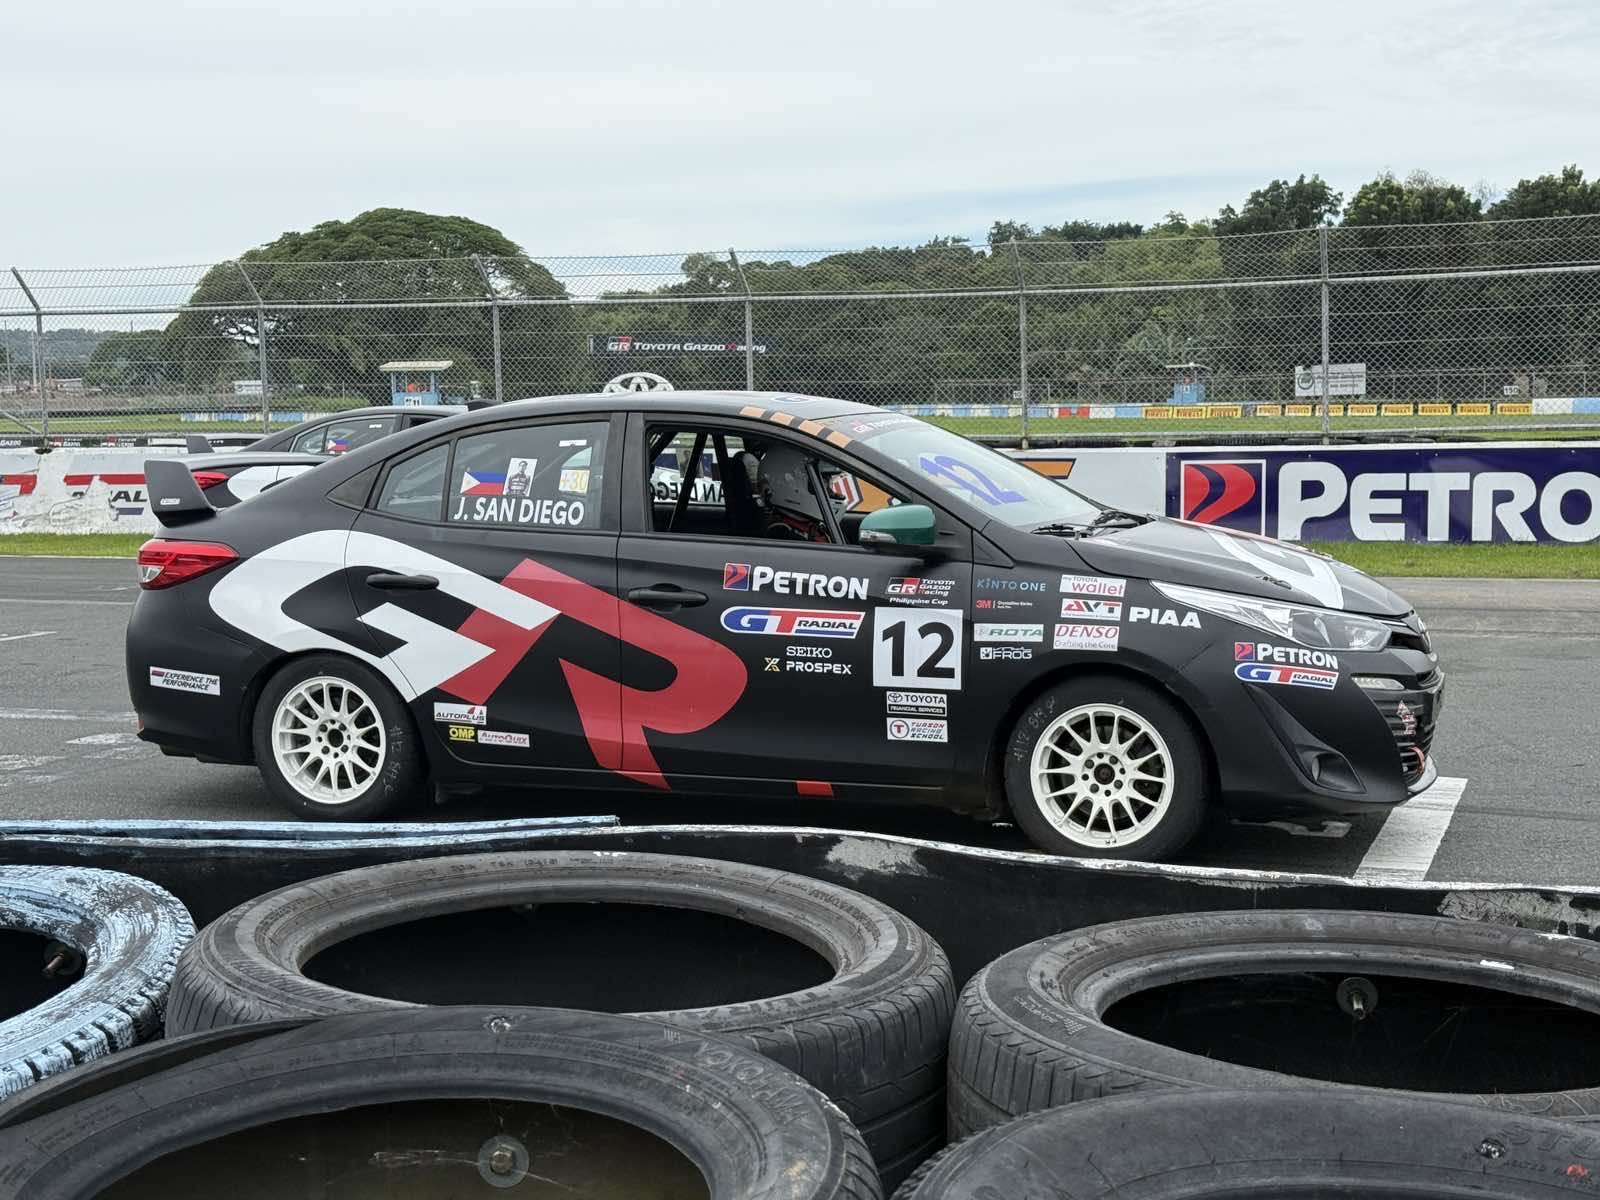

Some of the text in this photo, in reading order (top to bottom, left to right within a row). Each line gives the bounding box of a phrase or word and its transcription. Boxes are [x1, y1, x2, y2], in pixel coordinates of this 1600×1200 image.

[608, 342, 630, 350] GR
[633, 342, 681, 350] TOYOTA
[683, 342, 725, 350] GAZOO
[919, 456, 1027, 506] 12
[454, 497, 584, 525] J. SAN DIEGO
[752, 566, 869, 600] PETRON
[888, 584, 917, 593] GR
[976, 579, 1046, 591] KINTO ONE
[1072, 583, 1123, 595] wallet
[976, 600, 992, 608] 3M
[1064, 601, 1120, 614] AVT
[1129, 607, 1201, 628] PIAA
[797, 620, 856, 630] RADIAL
[1056, 626, 1118, 639] DENSO
[786, 646, 832, 658] SEIKO
[882, 621, 955, 678] 12
[993, 651, 1032, 659] FROG
[1257, 643, 1338, 669] PETRON
[786, 661, 851, 674] PROSPEX
[162, 679, 209, 690] PERFORMANCE
[165, 672, 218, 685] EXPERIENCE THE
[1293, 673, 1334, 684] RADIAL
[904, 694, 945, 704] TOYOTA
[436, 712, 485, 721] AUTOPLUS
[449, 727, 475, 739] OMP
